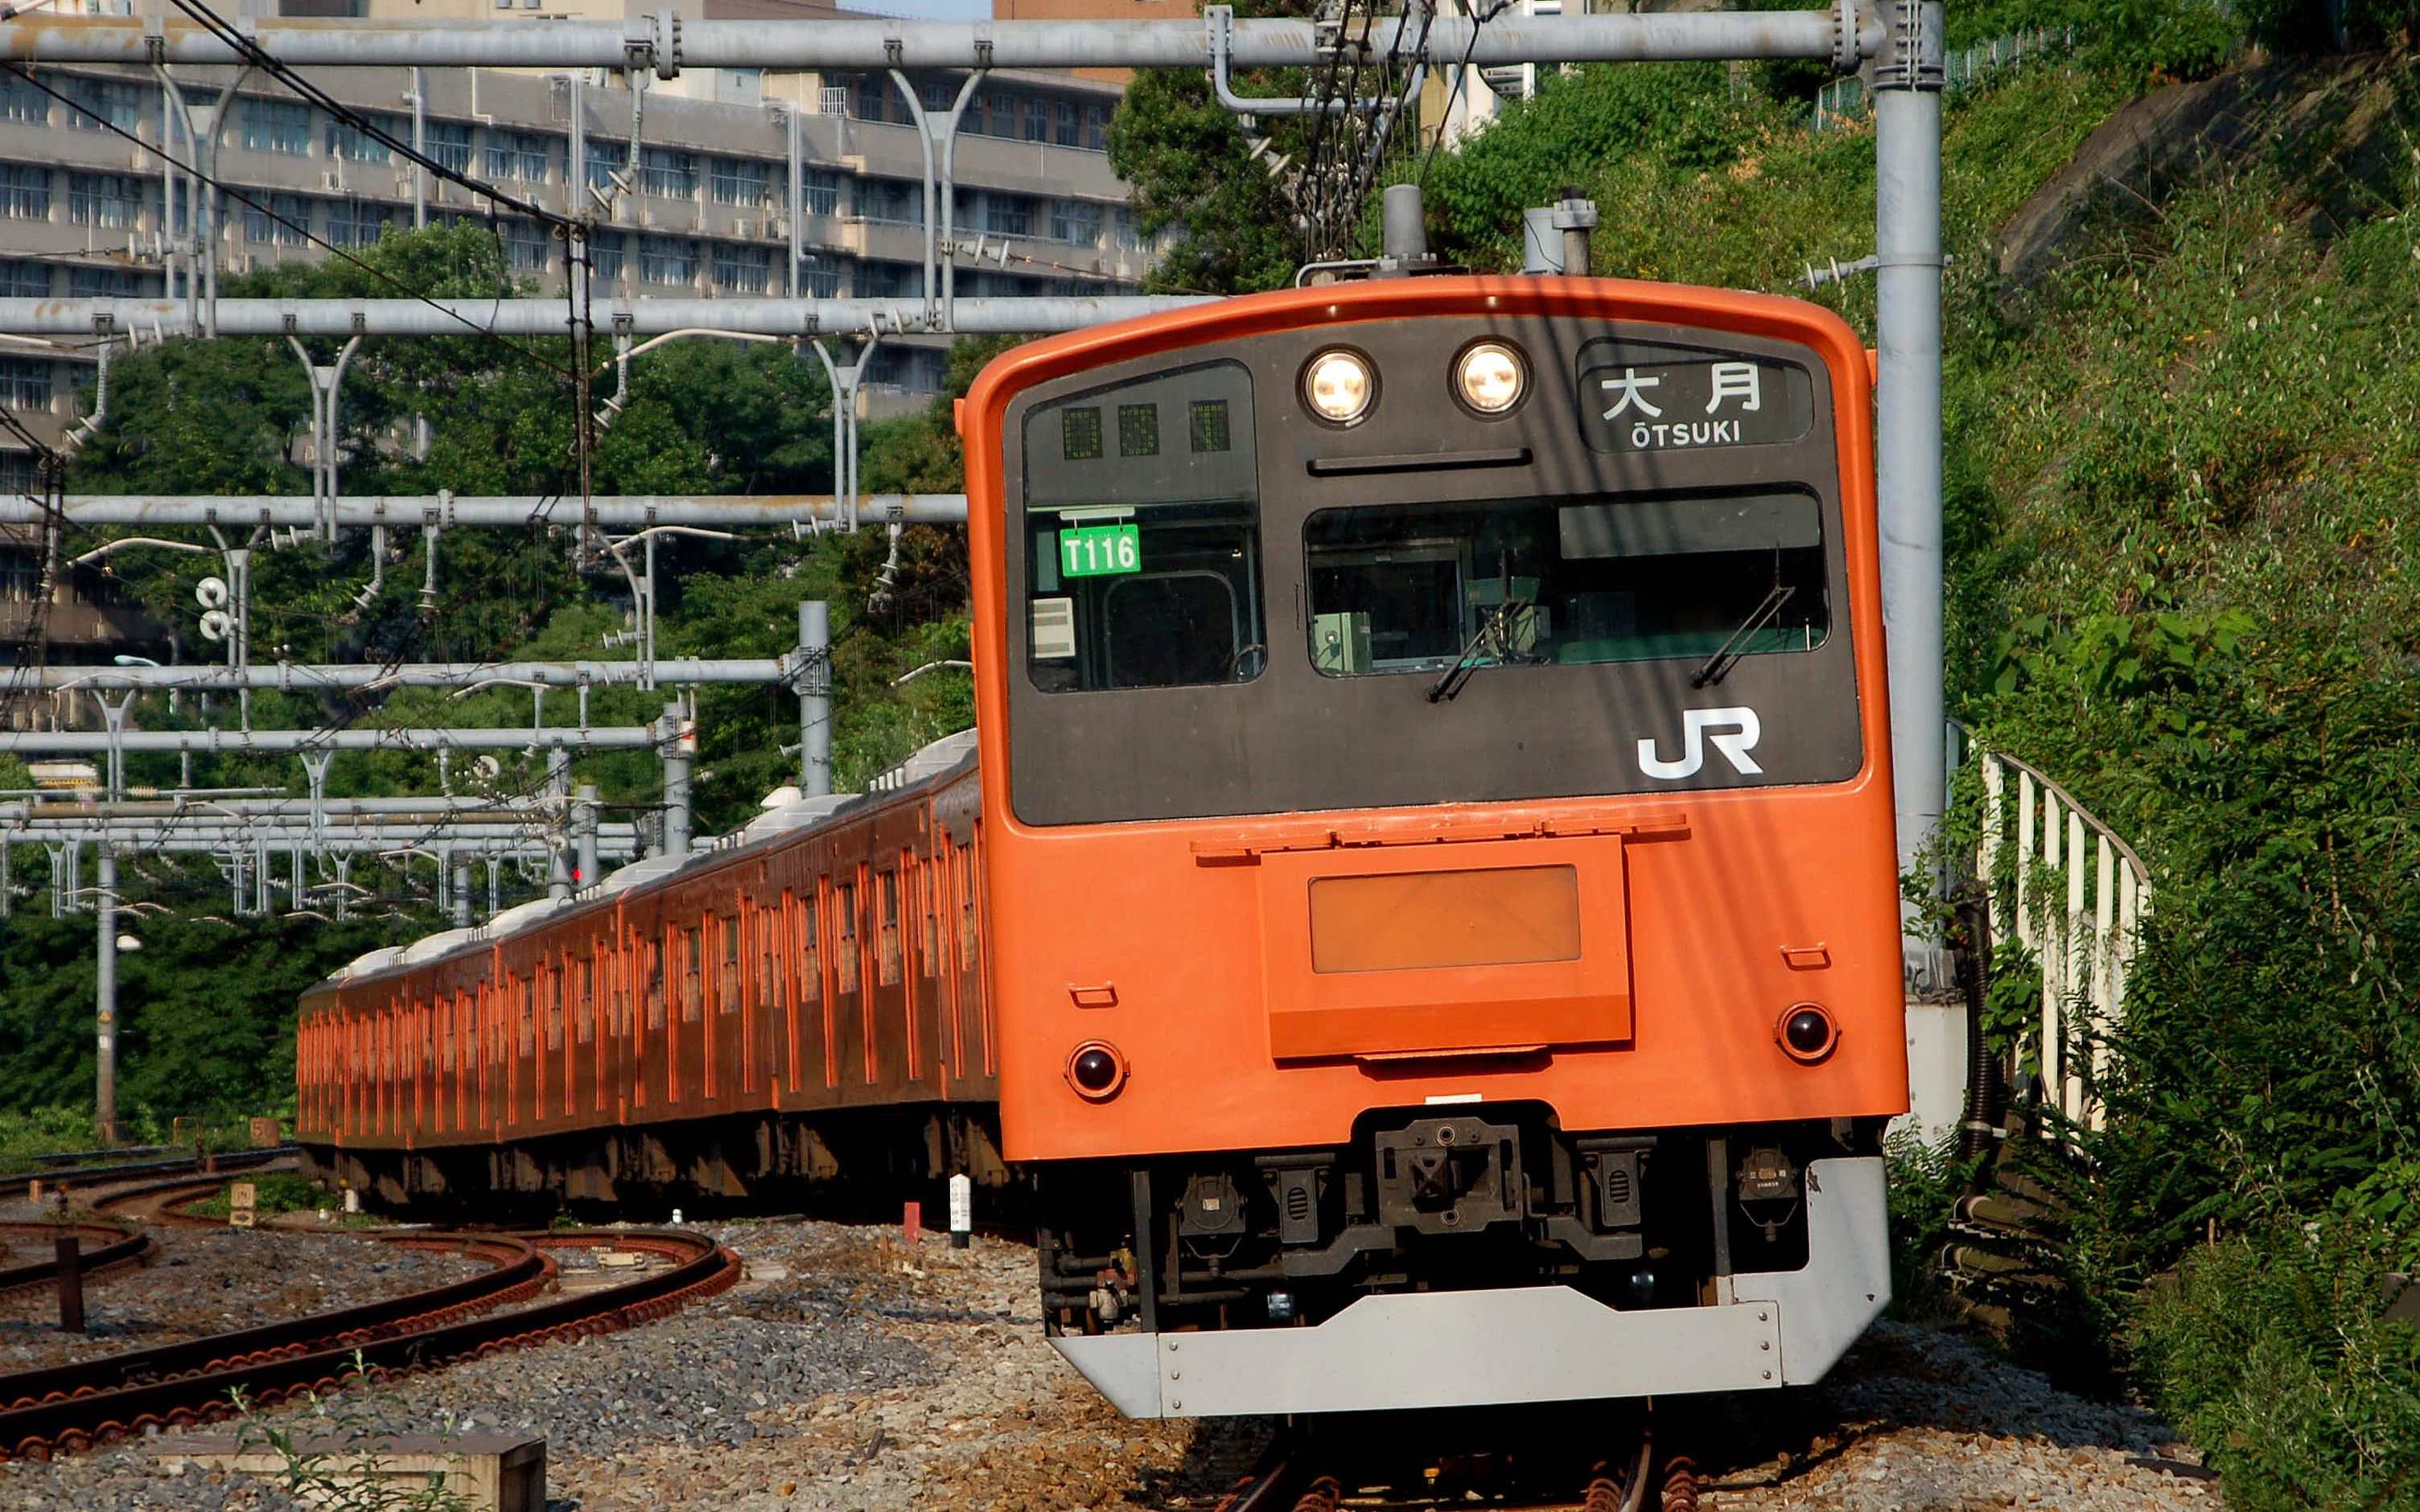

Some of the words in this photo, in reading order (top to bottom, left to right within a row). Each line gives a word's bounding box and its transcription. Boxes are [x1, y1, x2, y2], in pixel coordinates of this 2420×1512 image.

[1600, 362, 1760, 421] 大月
[1632, 418, 1741, 448] ŌTSUKI
[1064, 535, 1136, 572] T116
[1637, 706, 1764, 779] JR
